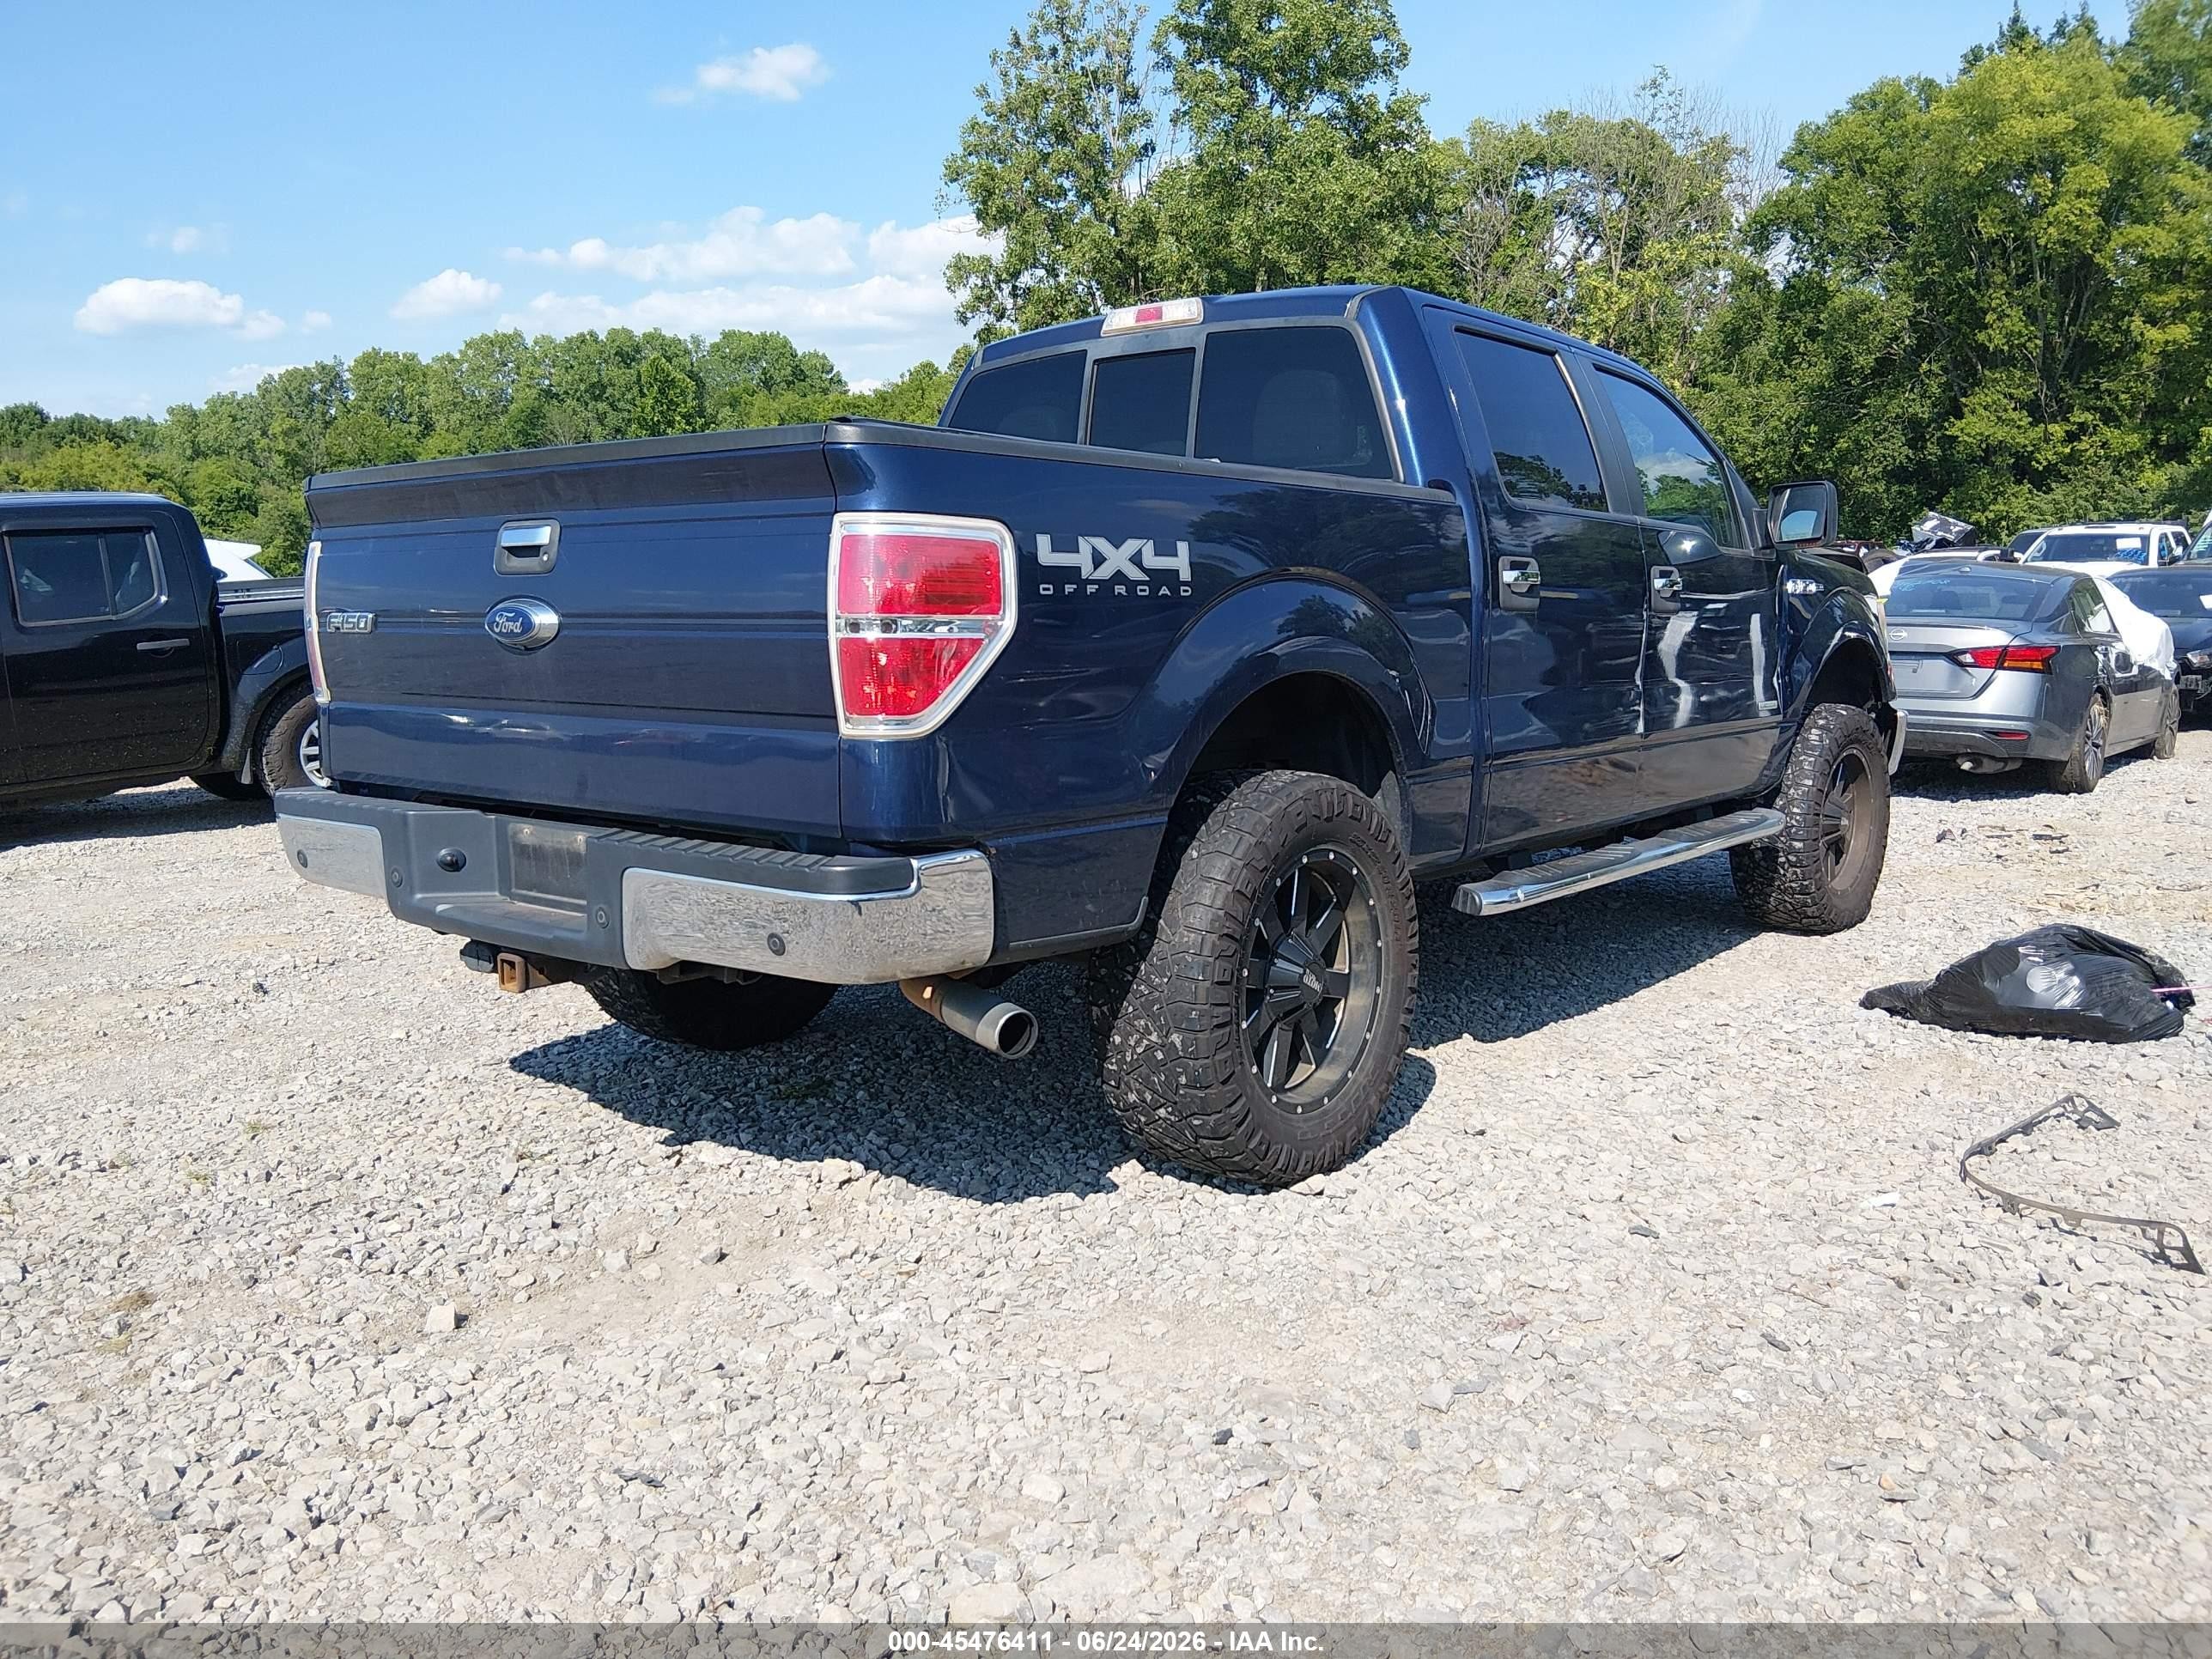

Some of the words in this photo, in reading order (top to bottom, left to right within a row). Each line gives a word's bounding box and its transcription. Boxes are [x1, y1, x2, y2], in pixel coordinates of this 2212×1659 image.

[1039, 584, 1099, 595] OFF
[1115, 585, 1192, 596] ROAD
[493, 611, 523, 633] Ford
